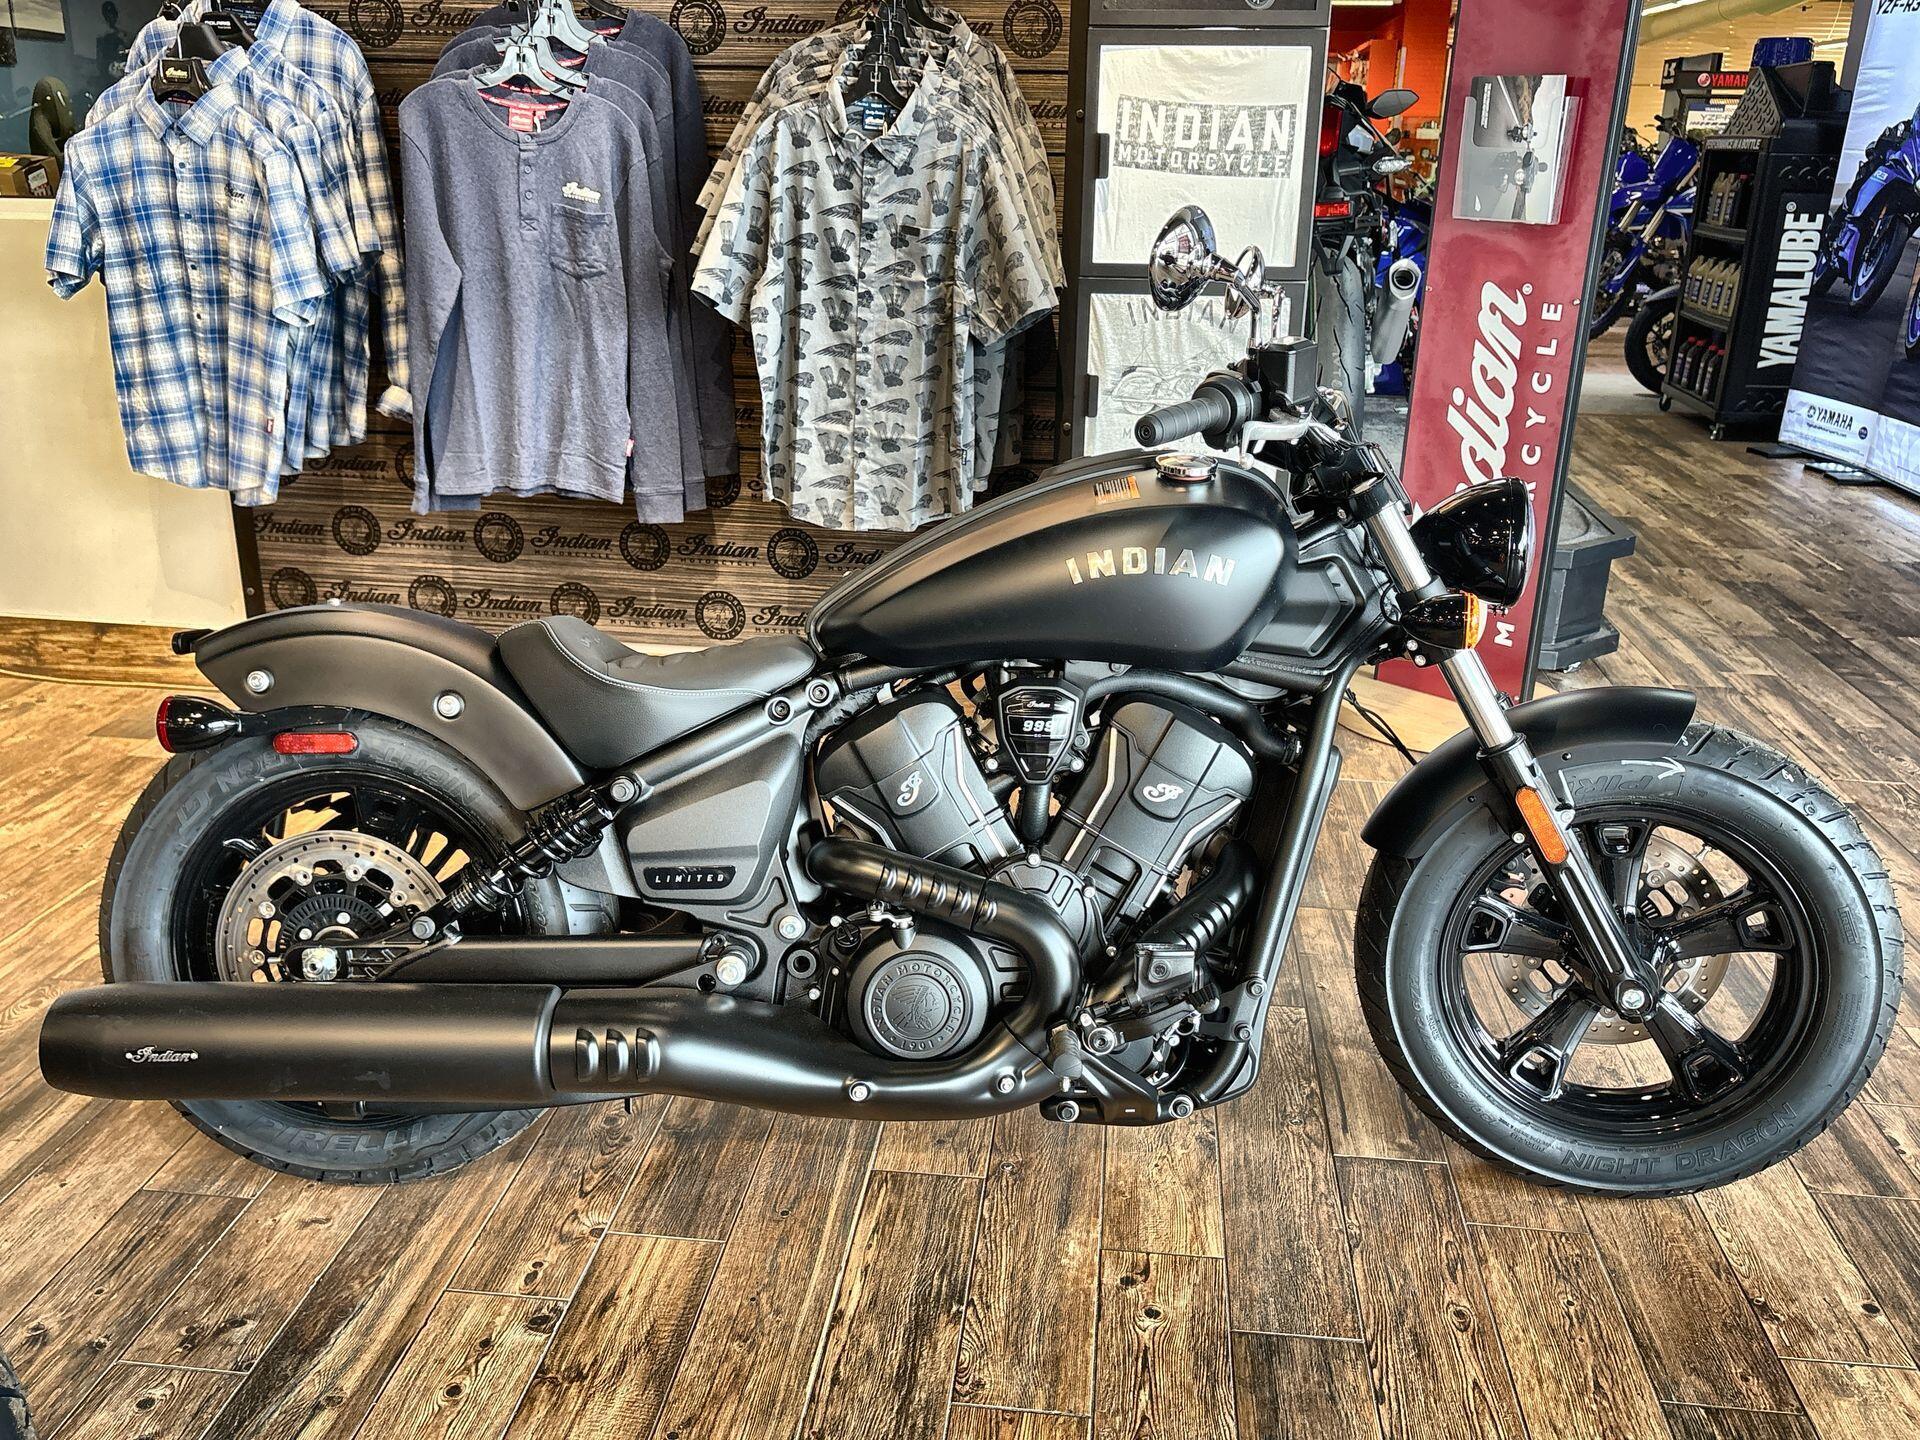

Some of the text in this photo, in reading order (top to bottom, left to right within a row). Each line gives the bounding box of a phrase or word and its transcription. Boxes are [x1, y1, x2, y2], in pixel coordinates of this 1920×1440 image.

[411, 0, 478, 27] Indi
[733, 6, 826, 34] Indian
[1712, 73, 1749, 87] YAMAH
[702, 96, 748, 116] dian
[1118, 99, 1291, 152] INDIAN
[1118, 143, 1287, 173] MOTORCYCLE
[1756, 213, 1825, 369] YAMALUBE
[1447, 281, 1528, 495] dian
[1816, 407, 1854, 431] YAMAHA
[387, 518, 466, 543] Indian
[530, 525, 612, 550] Indian
[534, 550, 612, 560] MOTORCYCLE
[677, 533, 758, 559] Indian
[825, 543, 884, 565] Indi
[680, 558, 757, 567] MOTORCYCLE
[1065, 547, 1236, 586] INDIAN
[463, 589, 542, 612] Indian
[607, 596, 688, 621] Indian
[610, 619, 686, 628] MOTORCYCLE
[752, 605, 807, 627] Indi
[655, 874, 724, 883] LIMITED
[896, 962, 961, 1034] MOTORCYCLE
[131, 1045, 191, 1063] Indian
[249, 1114, 423, 1153] PIRELLI
[1561, 1102, 1798, 1175] NIGHT DRAGON
